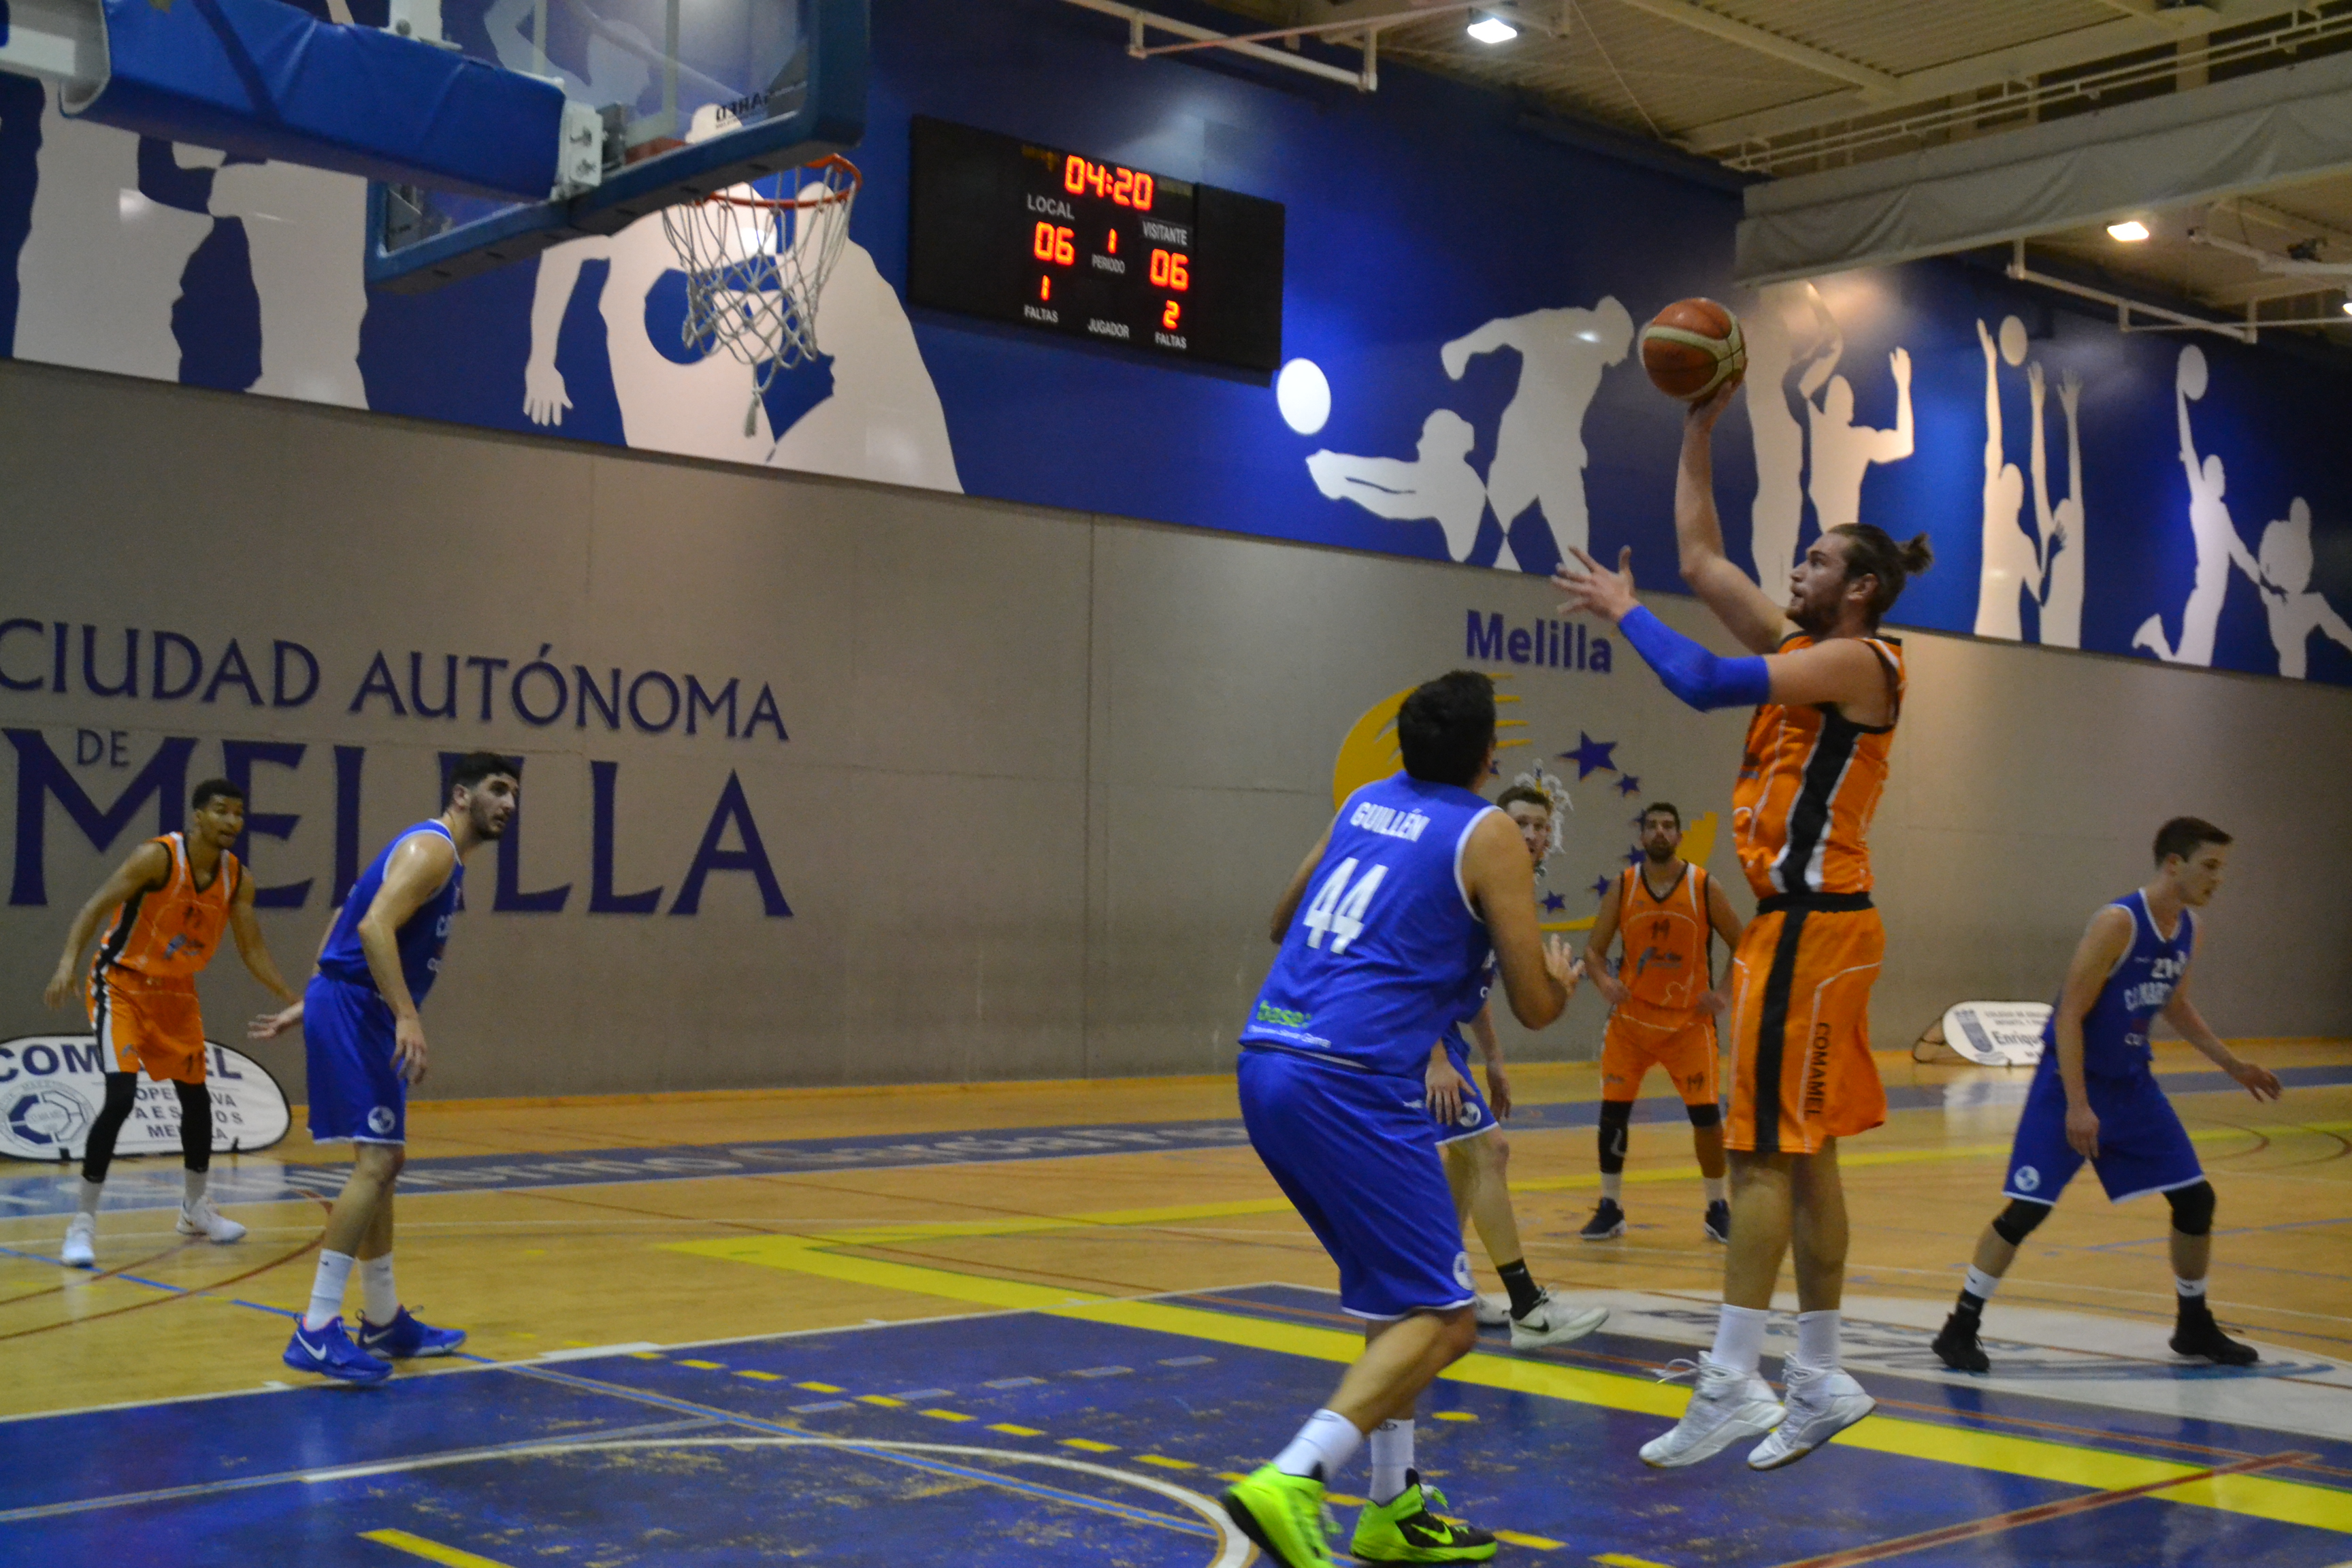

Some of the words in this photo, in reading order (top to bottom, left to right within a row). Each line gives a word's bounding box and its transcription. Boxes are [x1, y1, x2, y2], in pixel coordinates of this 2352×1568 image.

[1064, 154, 1154, 211] 04:20
[1026, 194, 1075, 220] LOCAL
[1034, 221, 1075, 265] 06
[1107, 228, 1118, 255] 1
[1143, 221, 1188, 246] VISITANTE
[1040, 274, 1051, 301] 1
[1149, 249, 1189, 291] 06
[1024, 304, 1059, 323] FALTAS
[1088, 317, 1130, 339] JUGADOR
[1162, 299, 1181, 330] 2
[1155, 331, 1187, 350] FALTAS
[1466, 609, 1612, 674] Melilla
[0, 617, 320, 708] CIUDAD
[348, 643, 790, 742] AUTÓNOMA
[76, 728, 131, 768] DE
[1350, 801, 1431, 843] GUILLÉN
[1303, 856, 1389, 955] 44
[1991, 1030, 2044, 1047] Enriqu
[1803, 1022, 1831, 1121] COMAMEL
